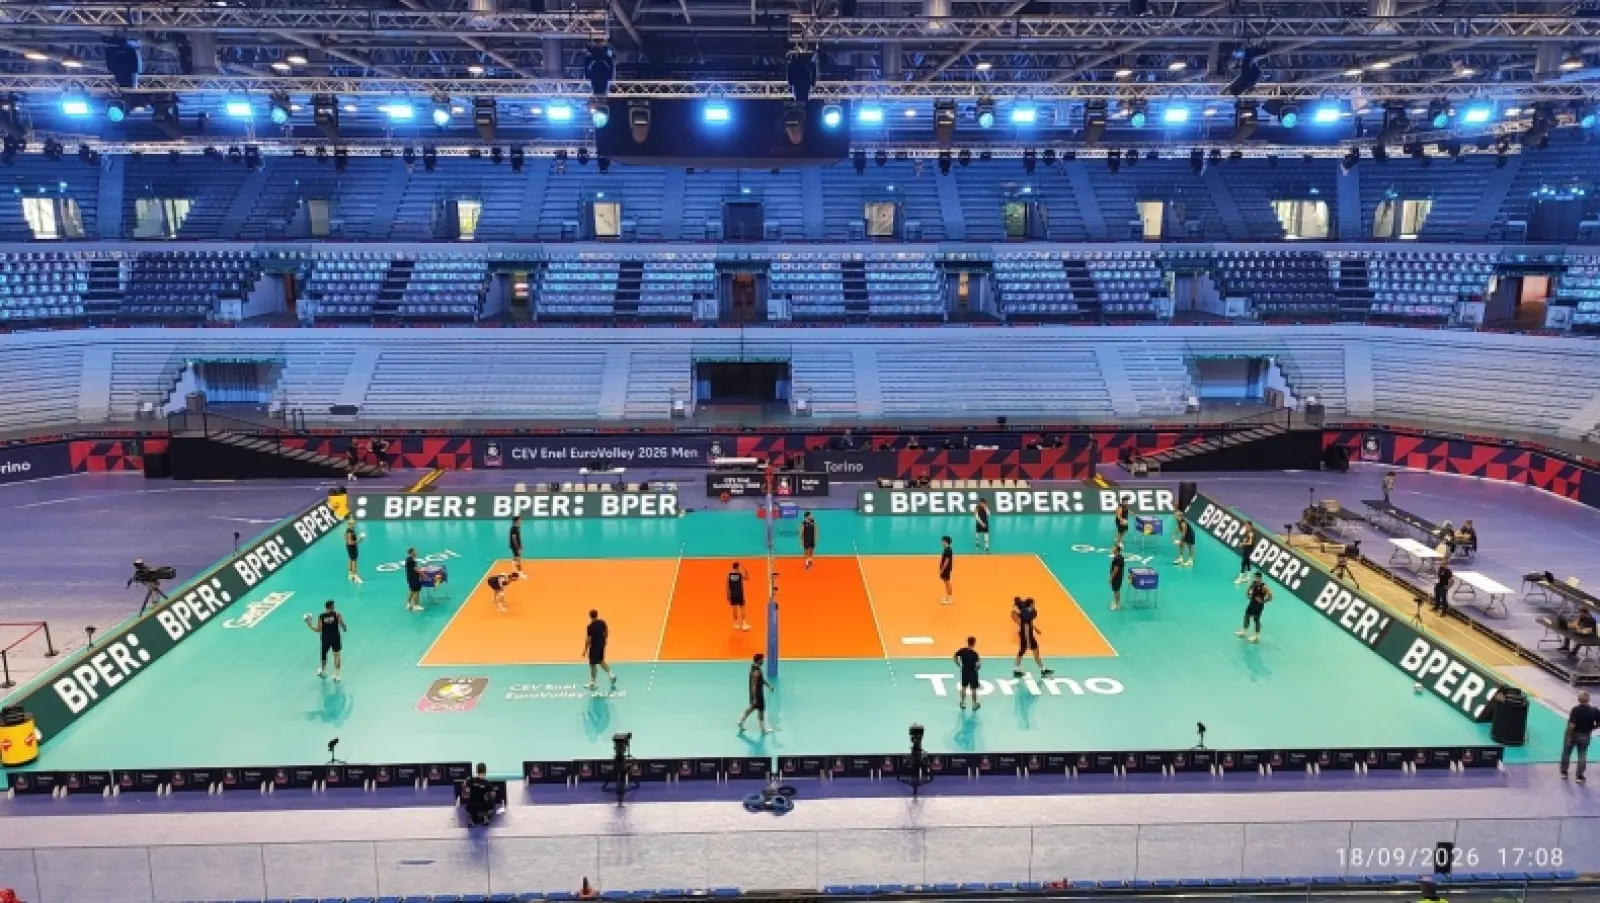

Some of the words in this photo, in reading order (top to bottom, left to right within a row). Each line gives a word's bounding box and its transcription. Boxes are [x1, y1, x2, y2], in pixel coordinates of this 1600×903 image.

[511, 447, 537, 459] CEV
[540, 447, 566, 459] Enel
[570, 447, 634, 460] EuroVolley
[637, 447, 667, 458] 2026
[671, 446, 698, 458] Men
[823, 460, 864, 473] Torino
[601, 494, 677, 516] BPER
[1100, 489, 1174, 512] BPER
